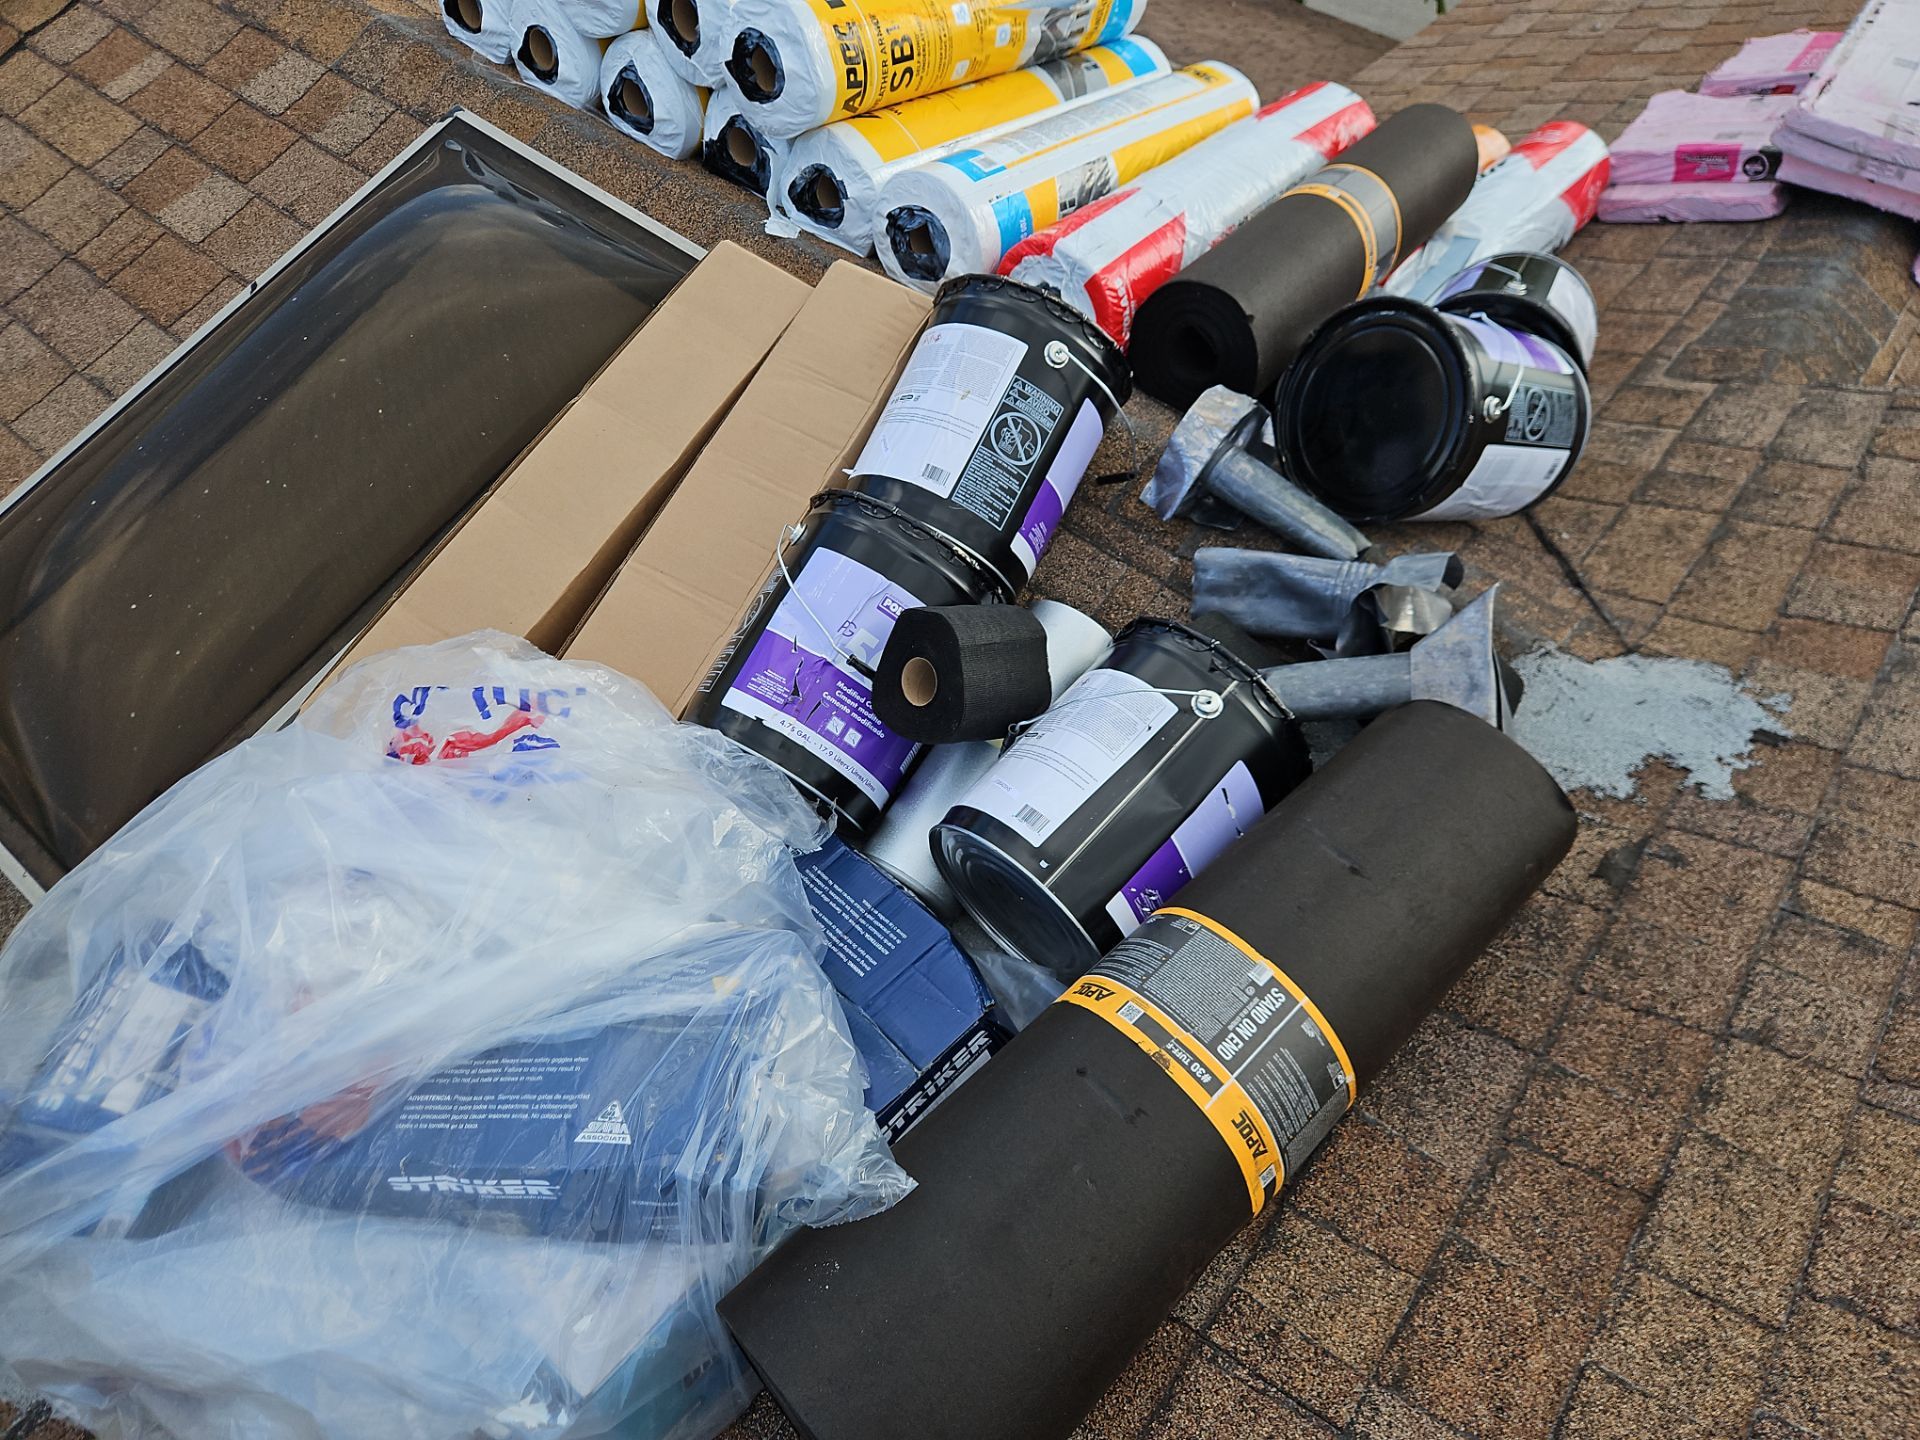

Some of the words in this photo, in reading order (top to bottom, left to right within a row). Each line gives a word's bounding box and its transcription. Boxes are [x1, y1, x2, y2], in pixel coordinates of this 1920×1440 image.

[832, 21, 867, 113] APOC
[1022, 383, 1061, 416] WARNING
[1025, 395, 1051, 417] AVISO
[1014, 399, 1054, 429] AVERTISSEMENT
[834, 689, 858, 708] Ciment
[835, 679, 866, 703] Modified
[821, 690, 851, 714] Cemento
[850, 710, 886, 739] modificado
[778, 717, 796, 733] 4.75
[795, 728, 813, 743] GAL
[817, 743, 834, 757] 17.9
[1072, 983, 1117, 1001] APOC
[1248, 985, 1287, 1026] STAND
[1234, 1016, 1259, 1041] ON
[1214, 1031, 1245, 1062] END
[1188, 1060, 1213, 1085] #30
[580, 1134, 627, 1142] ASSOCIATE
[1232, 1109, 1267, 1158] APOC
[388, 1174, 560, 1195] STRIKER
